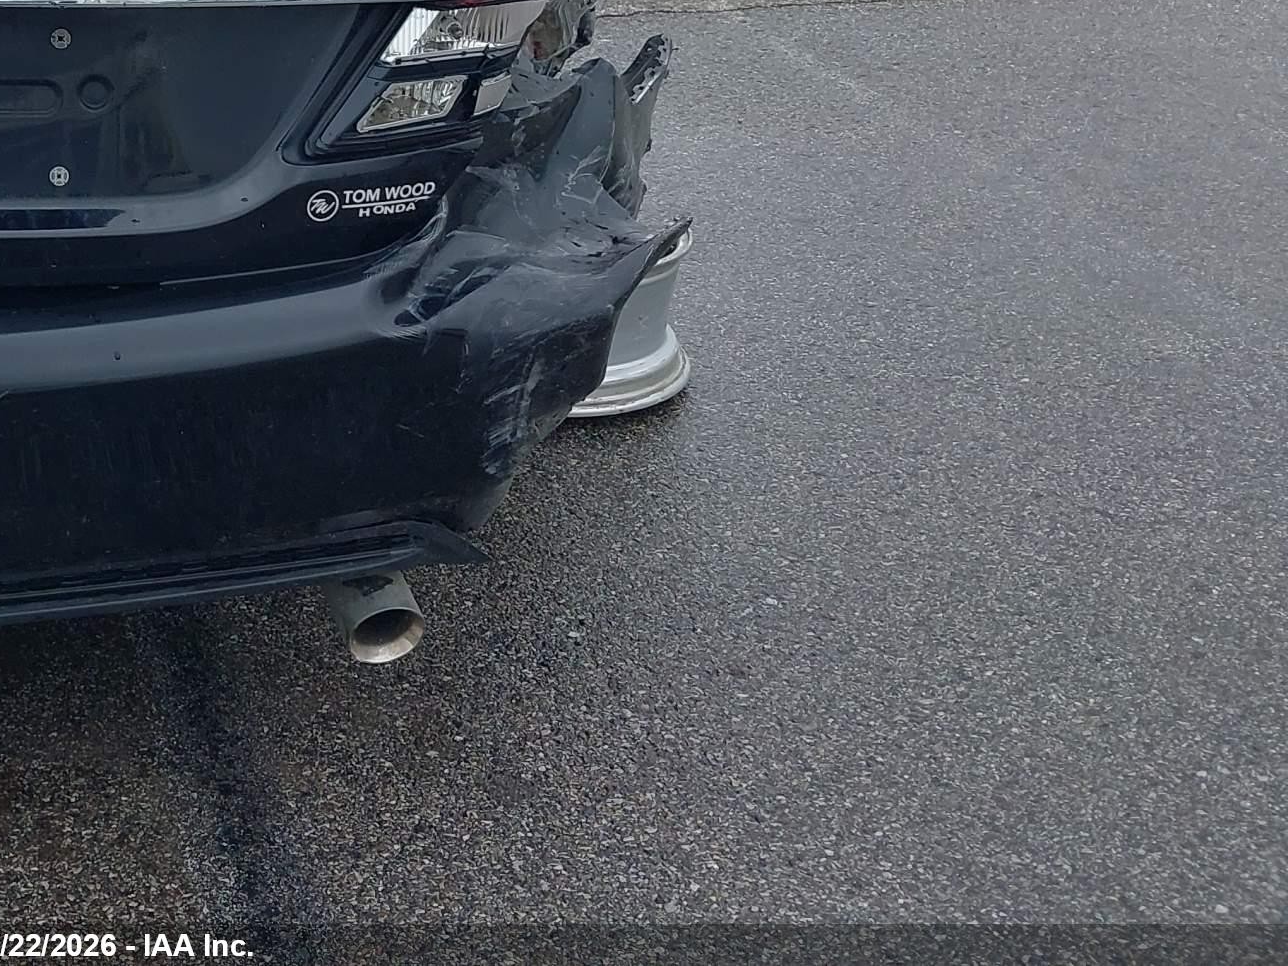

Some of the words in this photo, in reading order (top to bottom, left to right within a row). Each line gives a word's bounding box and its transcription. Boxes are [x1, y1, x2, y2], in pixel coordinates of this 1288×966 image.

[343, 189, 380, 203] TOM
[385, 182, 435, 199] WOOD
[358, 203, 416, 217] HONDA
